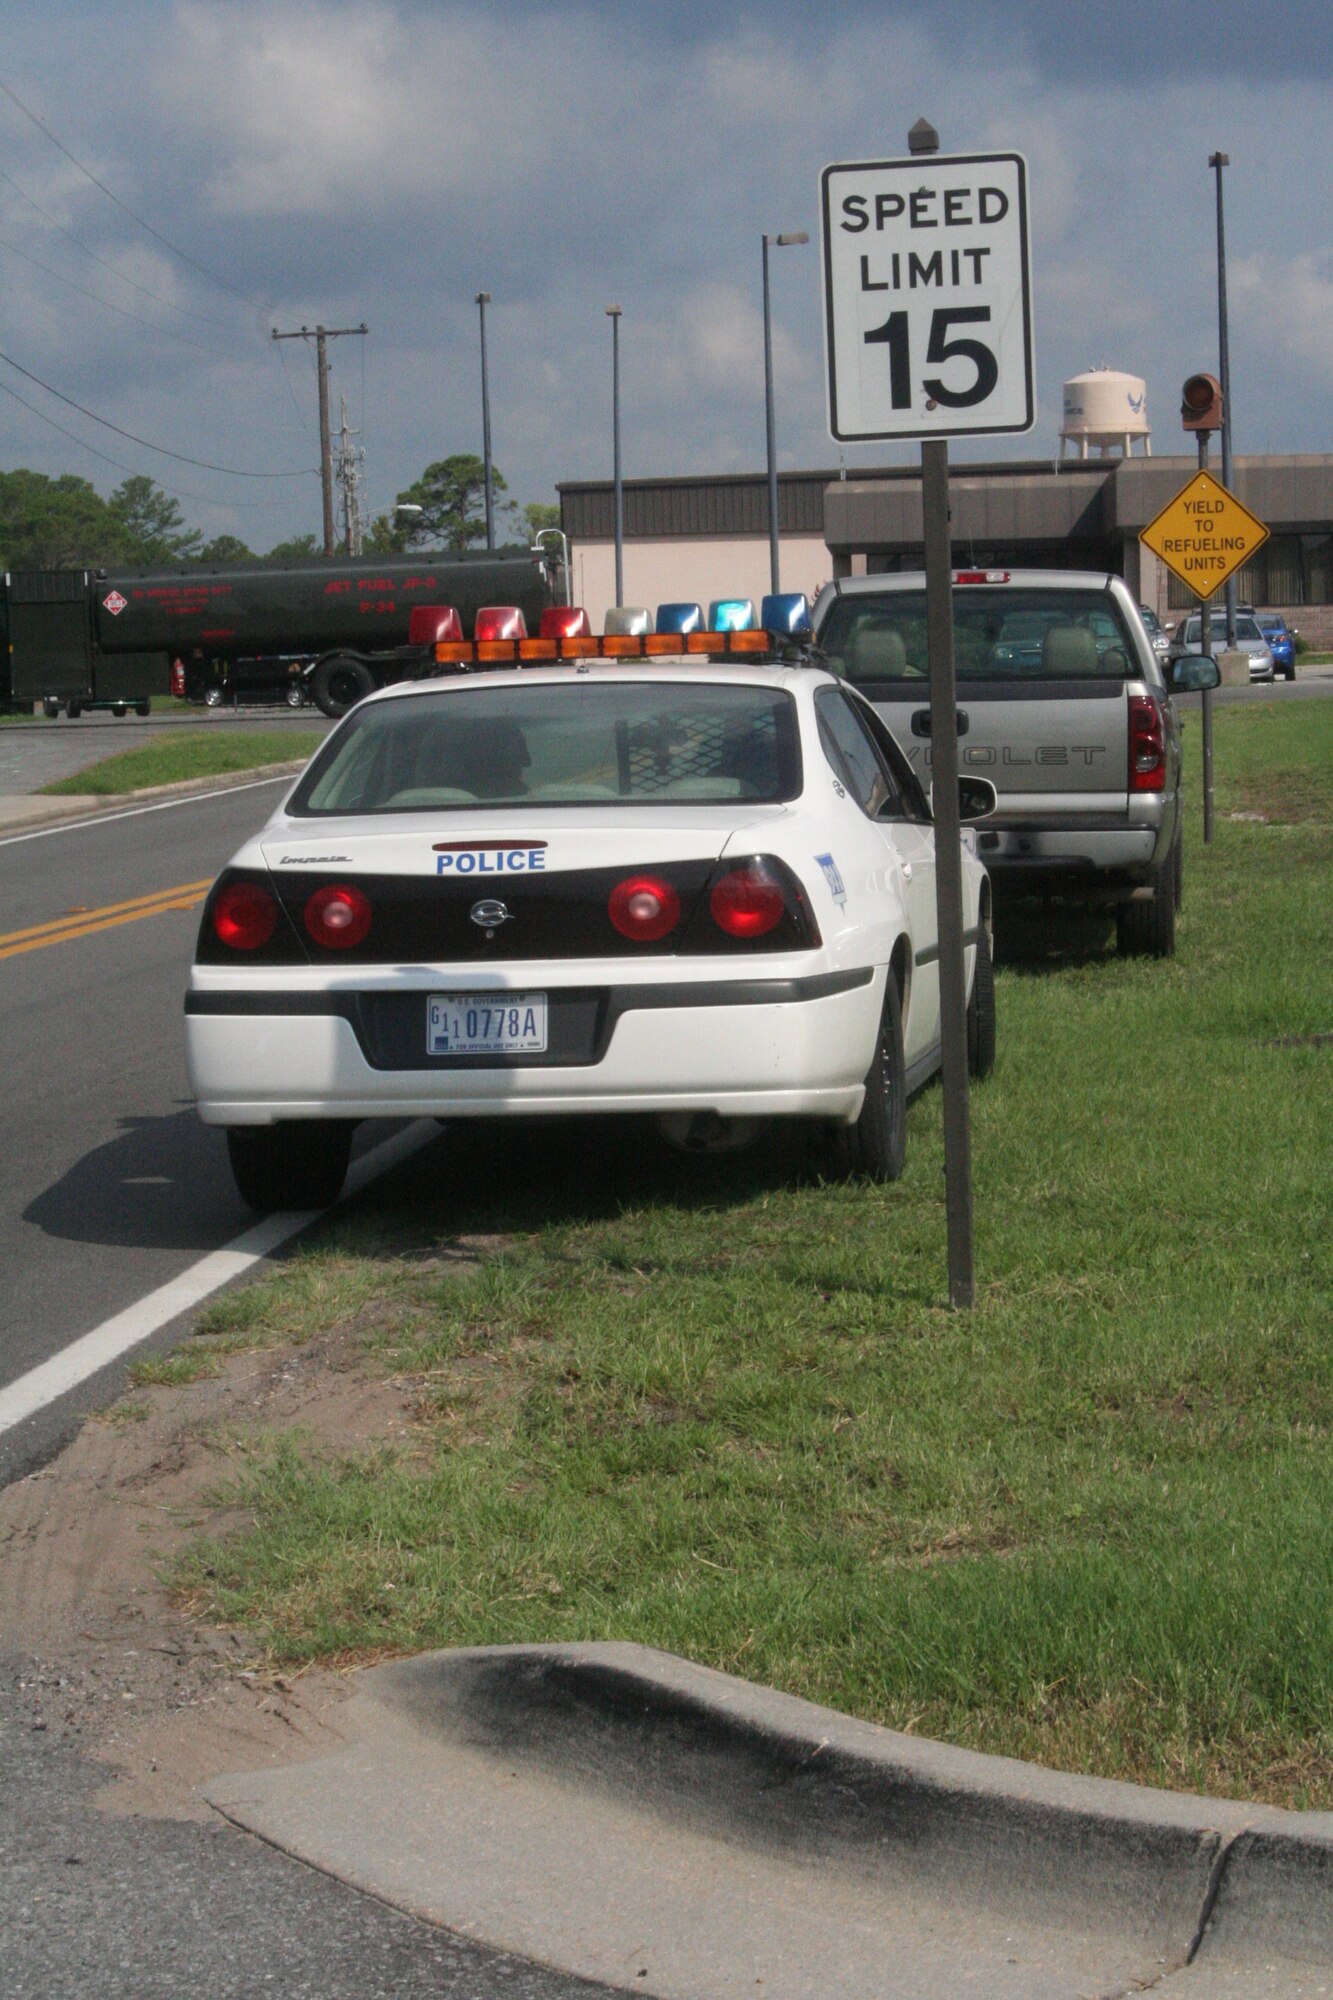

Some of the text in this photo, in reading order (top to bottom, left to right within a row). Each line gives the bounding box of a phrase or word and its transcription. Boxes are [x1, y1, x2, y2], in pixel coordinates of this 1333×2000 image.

[840, 187, 1009, 233] SPEED
[861, 247, 991, 291] LIMIT
[864, 305, 998, 410] 15
[1183, 500, 1225, 514] YIELD
[1194, 520, 1214, 532] TO
[1164, 537, 1245, 552] REFUELING
[1184, 556, 1226, 571] UNITS
[325, 580, 352, 594] JET
[357, 578, 397, 591] FUEL
[436, 850, 546, 875] POLICE
